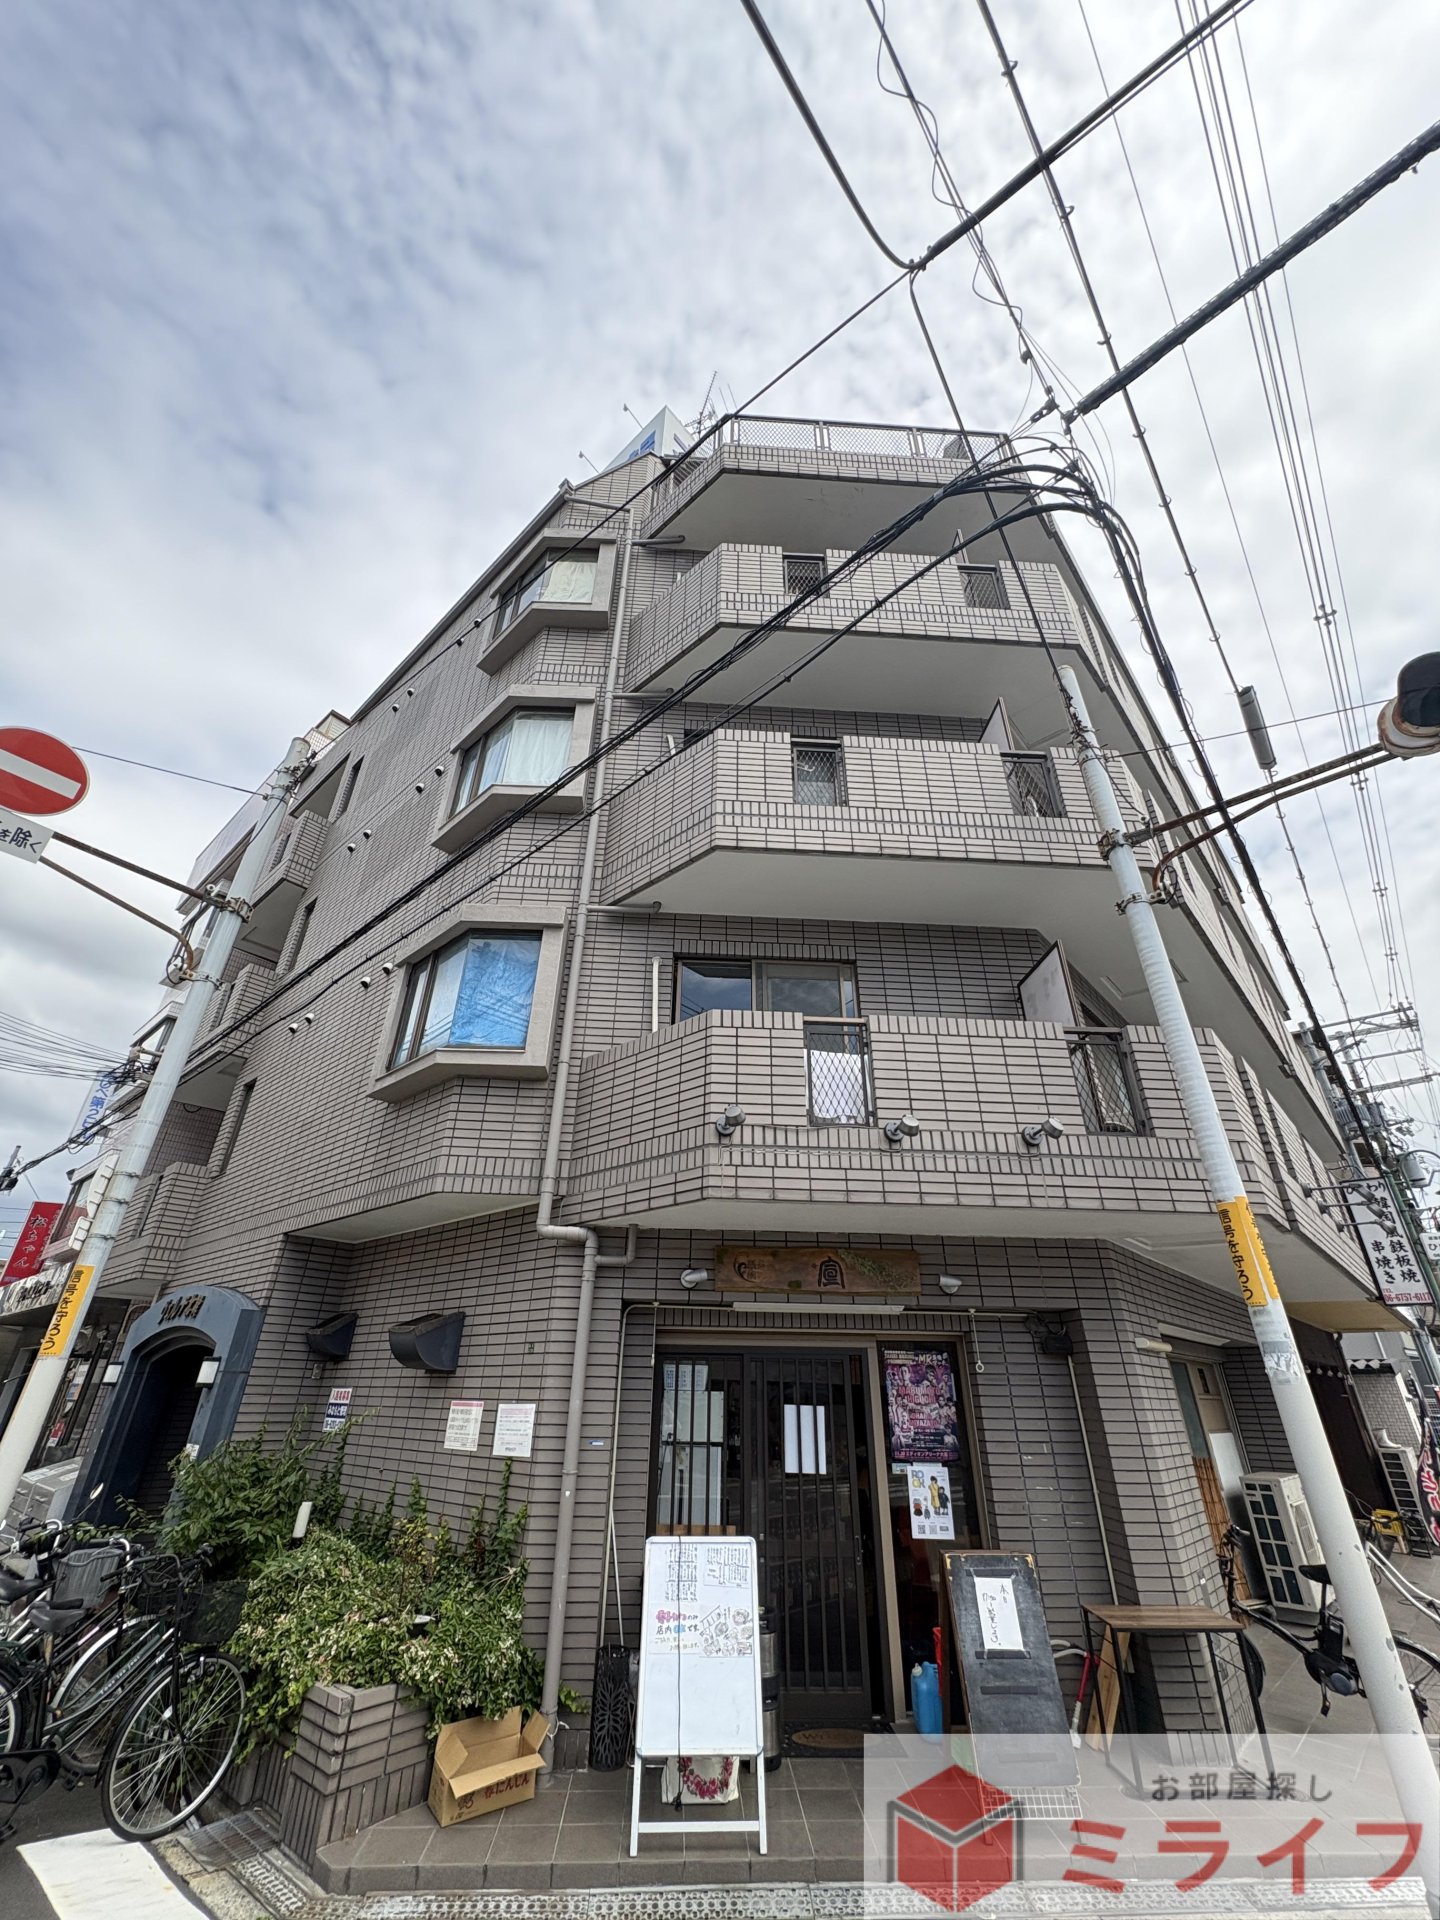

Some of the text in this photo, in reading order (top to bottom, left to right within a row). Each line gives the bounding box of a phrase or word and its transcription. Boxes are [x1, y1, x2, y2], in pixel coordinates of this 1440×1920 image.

[13, 1214, 49, 1268] 松ちゃん
[1371, 1240, 1396, 1284] 串焼き
